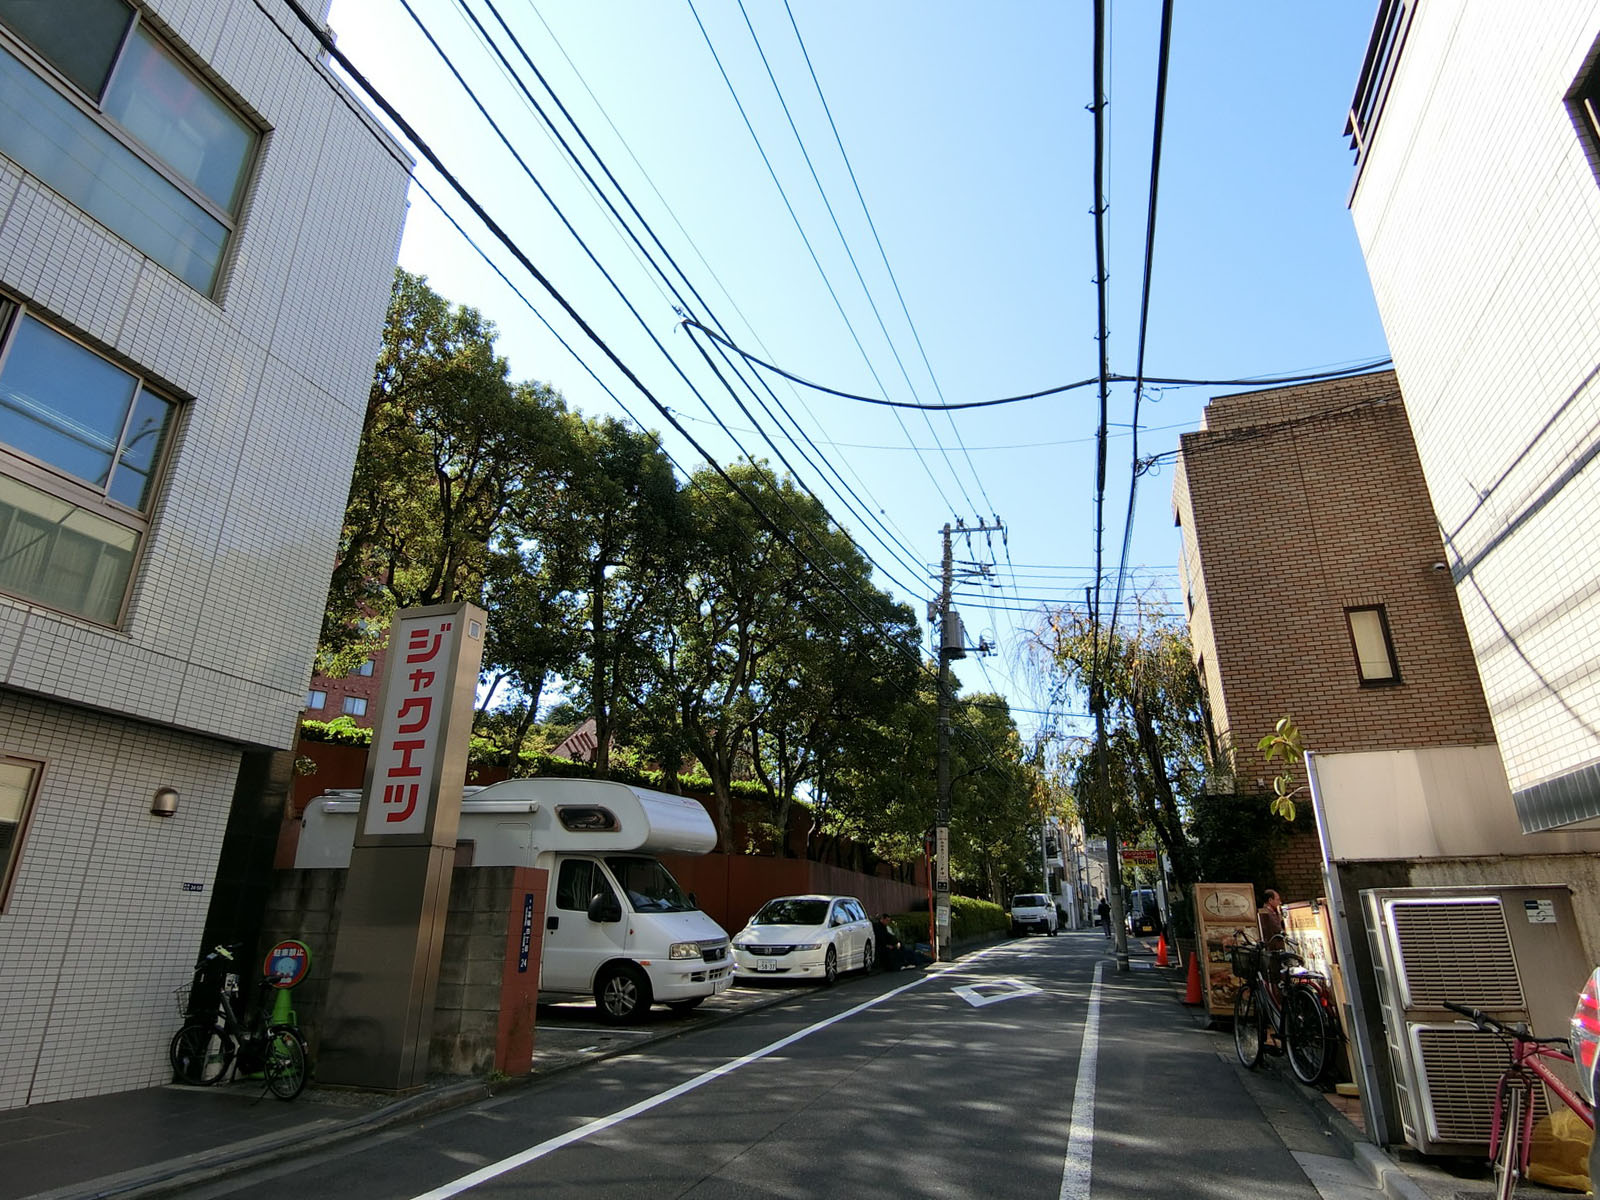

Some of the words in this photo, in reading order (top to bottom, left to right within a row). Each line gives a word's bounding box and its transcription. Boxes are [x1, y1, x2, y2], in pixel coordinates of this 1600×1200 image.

[384, 623, 451, 822] ジャクエツ
